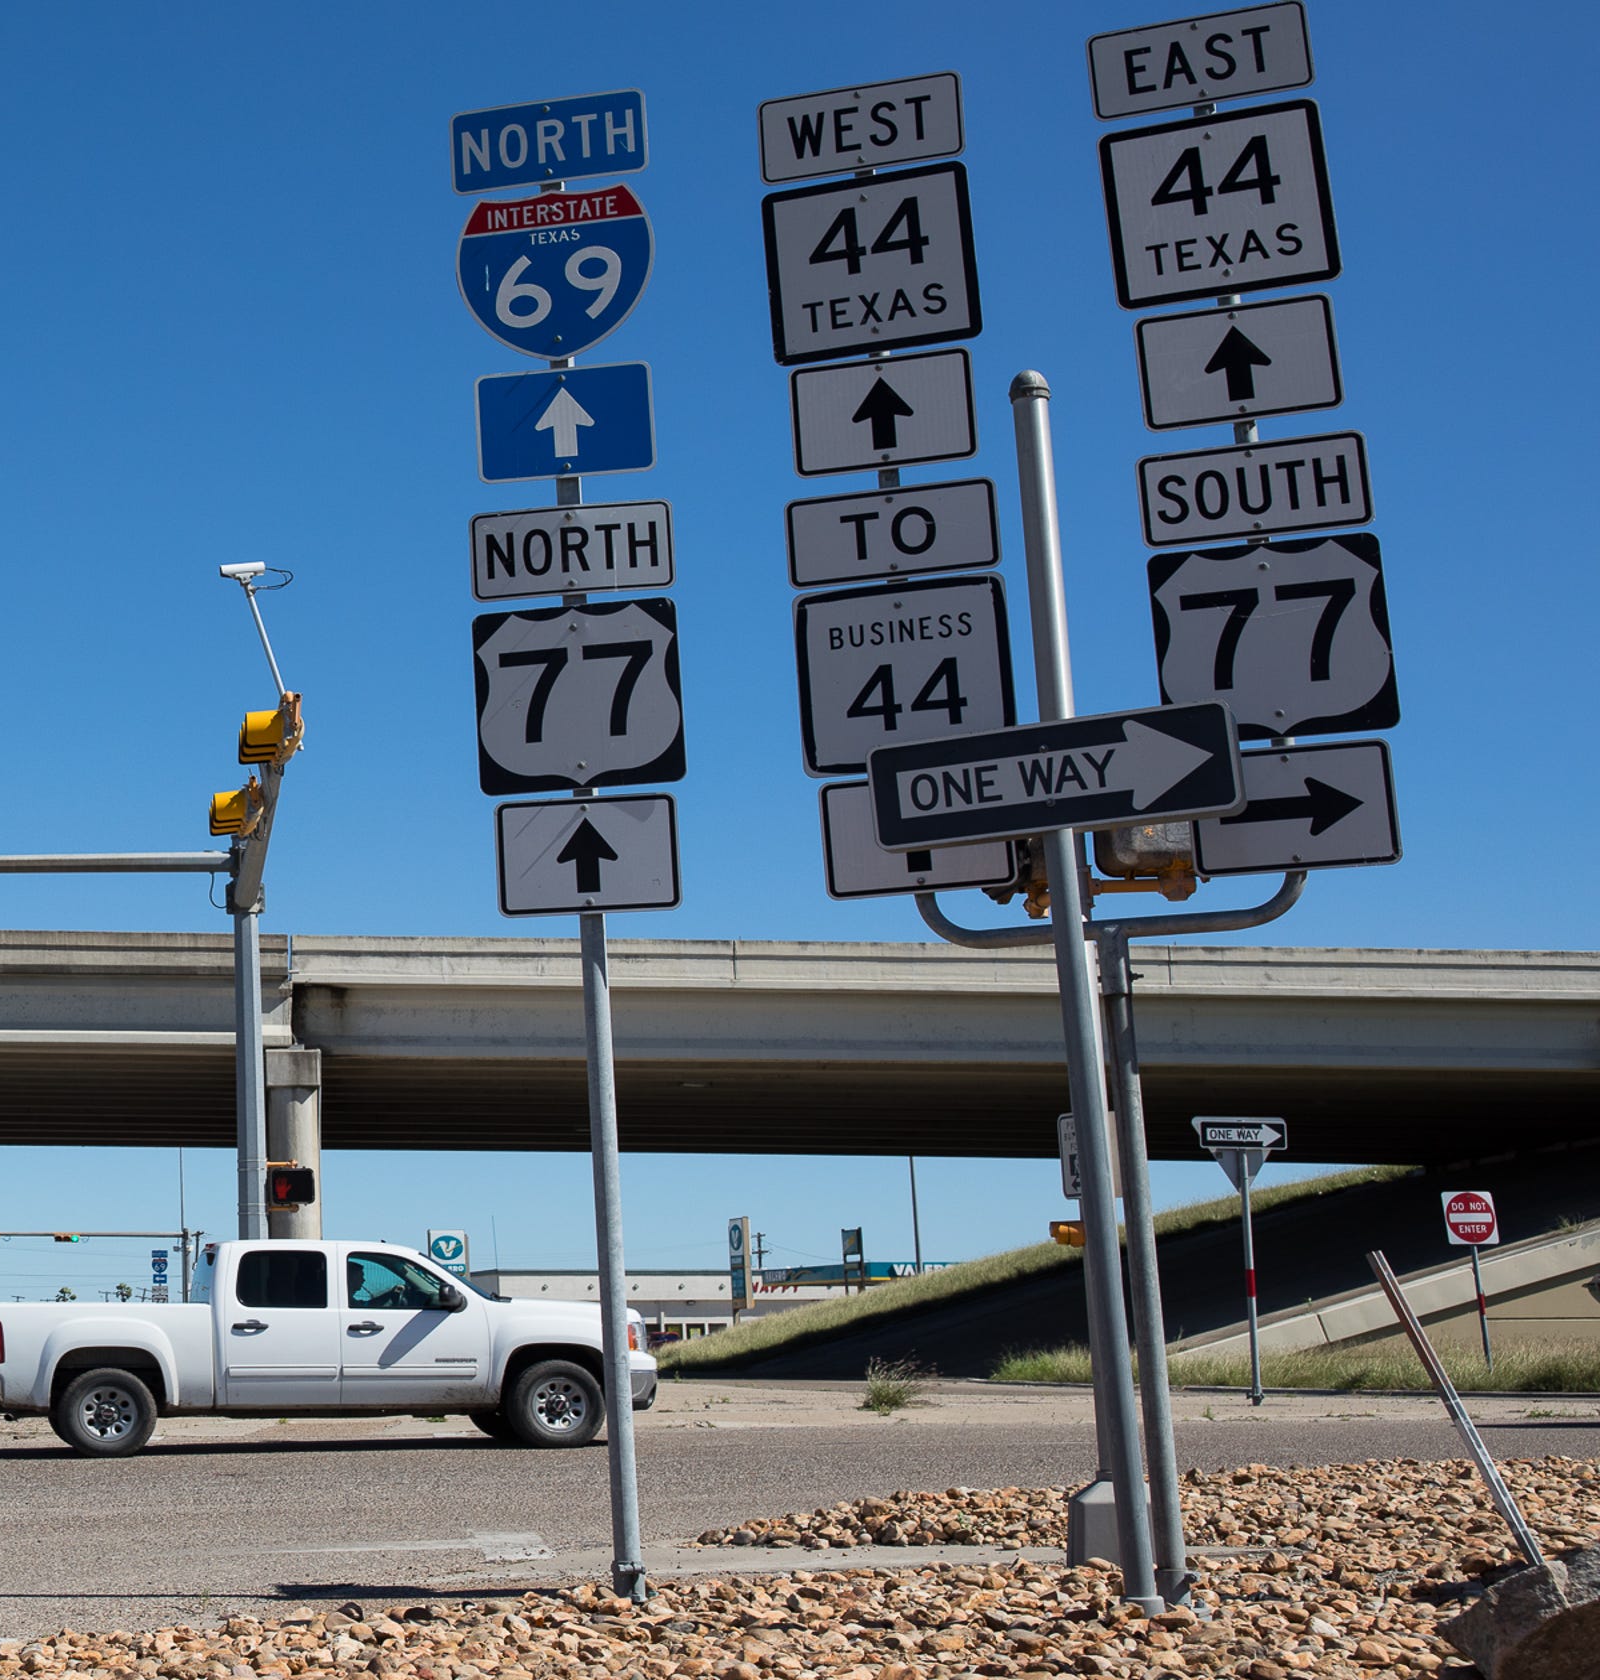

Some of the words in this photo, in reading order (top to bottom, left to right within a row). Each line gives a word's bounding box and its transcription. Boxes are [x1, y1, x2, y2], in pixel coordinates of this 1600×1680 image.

[1124, 25, 1271, 95] EAST
[461, 108, 636, 175] NORTH
[786, 95, 932, 160] WEST
[1151, 134, 1281, 216] 44
[486, 194, 619, 230] INTERSTATE
[528, 227, 581, 245] TEXAS
[809, 197, 930, 275] 44
[1145, 222, 1304, 277] TEXAS
[495, 245, 622, 328] 69
[802, 281, 949, 333] TEXAS
[1156, 454, 1351, 525] SOUTH
[486, 520, 659, 580] NORTH
[840, 505, 936, 561] TO
[829, 611, 973, 650] BUSINESS
[1179, 577, 1357, 691] 77
[498, 638, 654, 744] 77
[846, 656, 968, 731] 44
[910, 767, 1004, 812] ONE
[1018, 748, 1117, 796] WAY
[1209, 1129, 1232, 1139] ONE
[1236, 1129, 1260, 1140] WAY
[1451, 1202, 1465, 1211] DO
[1469, 1202, 1487, 1211] NOT
[1459, 1224, 1487, 1233] ENTER
